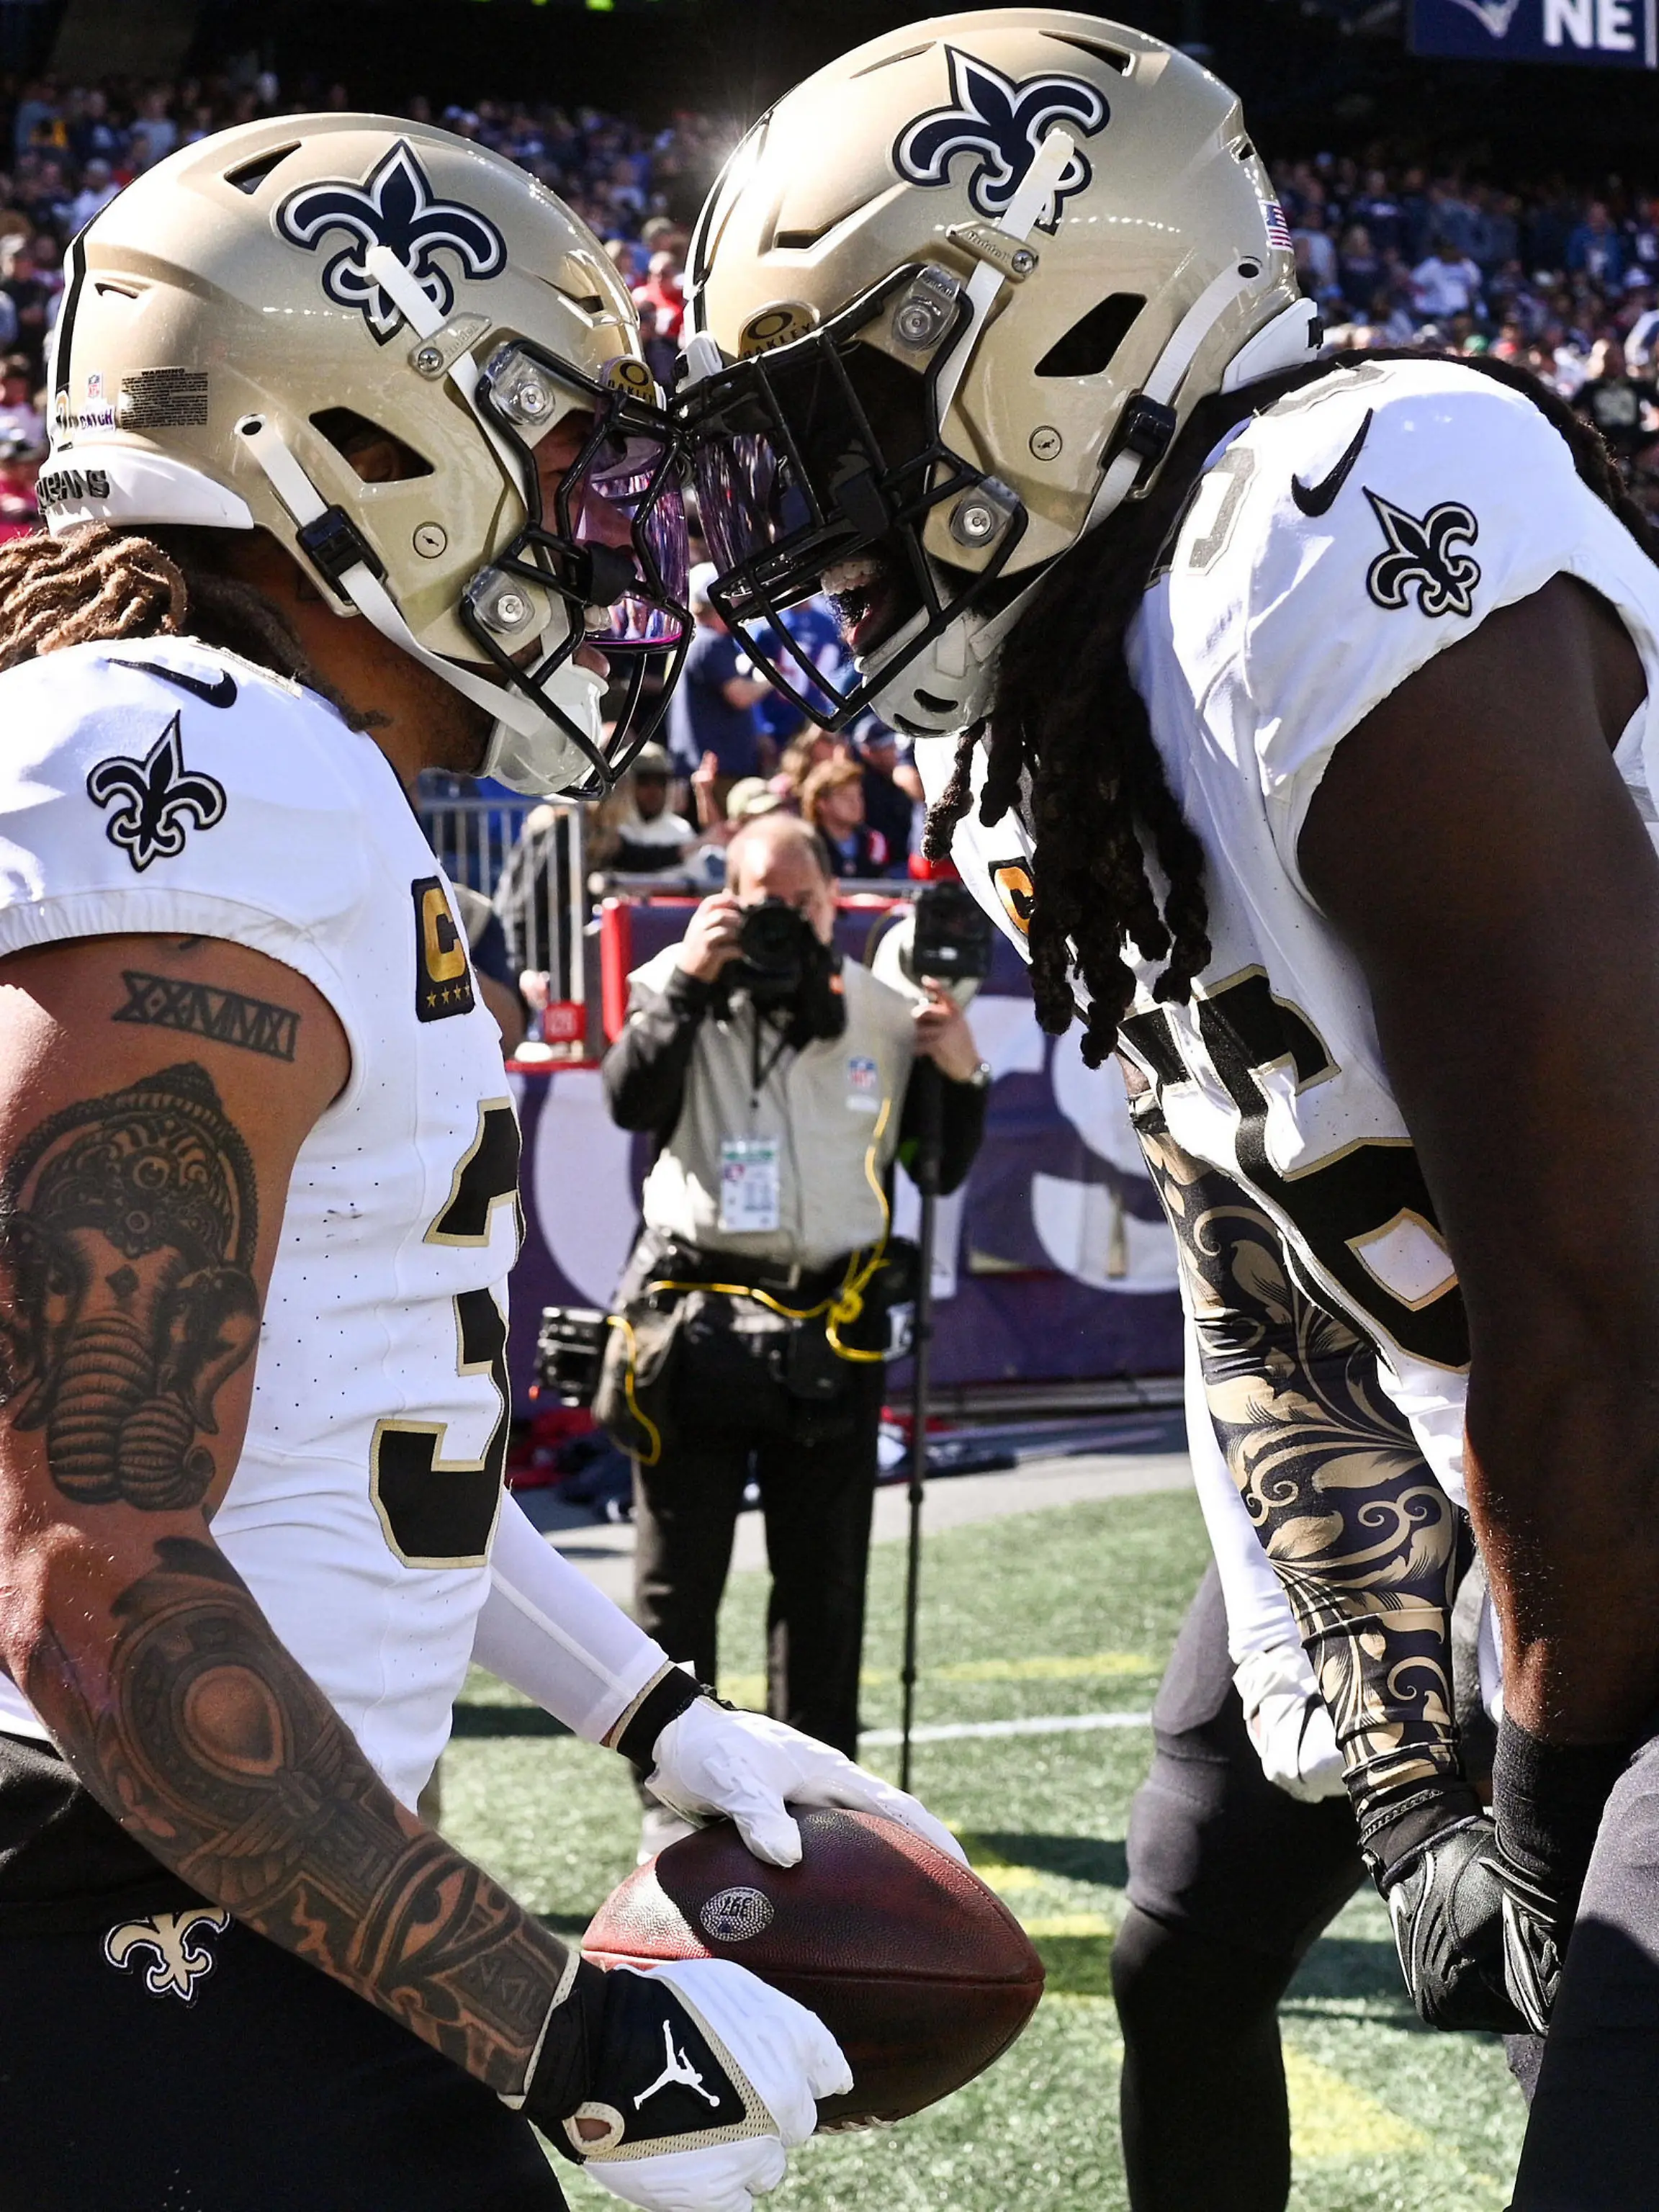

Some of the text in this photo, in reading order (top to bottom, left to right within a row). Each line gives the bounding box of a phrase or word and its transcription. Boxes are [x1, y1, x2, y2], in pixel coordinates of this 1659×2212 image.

[1542, 0, 1635, 51] NE
[994, 866, 1034, 934] C
[423, 888, 465, 982] C
